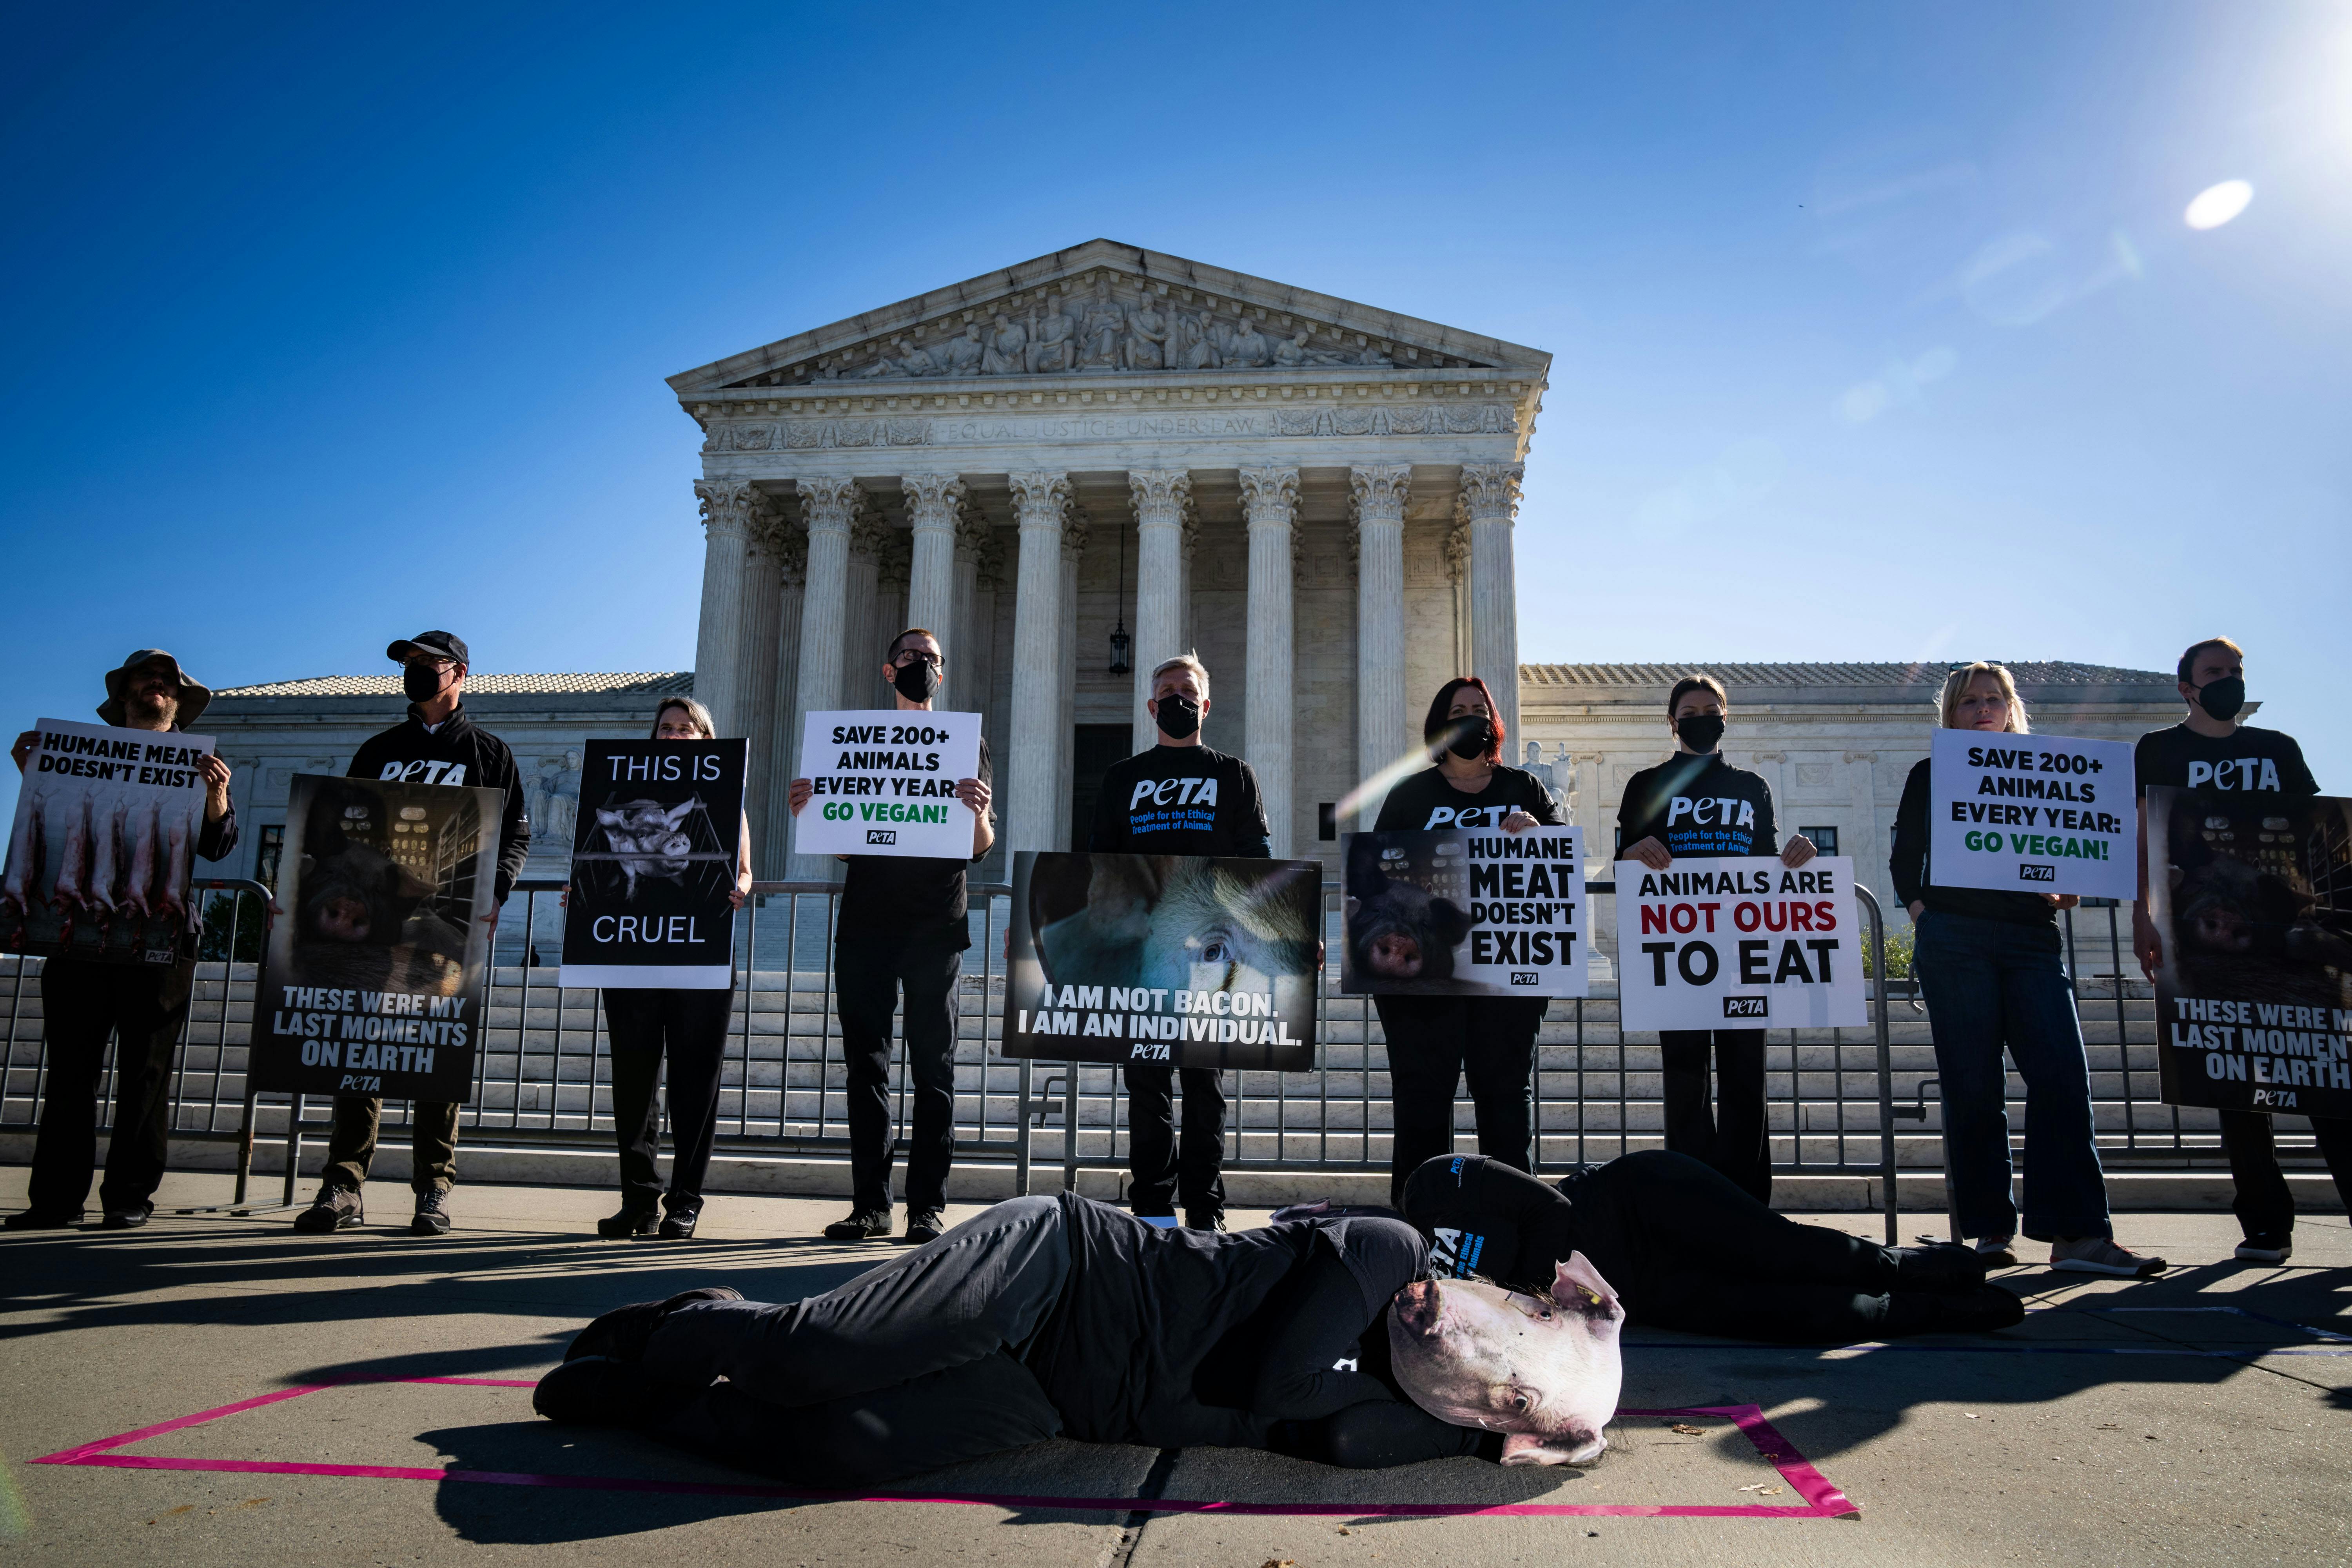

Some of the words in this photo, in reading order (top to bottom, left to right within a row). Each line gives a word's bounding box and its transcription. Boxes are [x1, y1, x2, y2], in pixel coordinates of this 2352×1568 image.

[948, 422, 1022, 440] EQUAL
[1028, 420, 1114, 437] JUSTICE
[1127, 418, 1202, 434] UNDER
[1211, 417, 1255, 433] LAW
[43, 732, 141, 760] HUMANE
[145, 745, 202, 767] MEAT
[832, 726, 886, 744] SAVE
[891, 726, 949, 745] 200+
[38, 754, 135, 782] DOESN'T
[139, 766, 199, 788] EXIST
[607, 756, 680, 780] THIS
[693, 755, 720, 780] IS
[837, 752, 940, 771] ANIMALS
[1968, 748, 2033, 770] SAVE
[2039, 753, 2102, 775] 200+
[814, 777, 886, 795] EVERY
[1978, 776, 2095, 803] ANIMALS
[823, 802, 853, 820] GO
[860, 803, 947, 823] VEGAN!
[1130, 811, 1154, 825] People
[1157, 811, 1169, 820] for
[1172, 810, 1185, 819] the
[1188, 809, 1215, 821] Ethical
[1952, 802, 2038, 826] EVERY
[2043, 808, 2120, 834] YEAR:
[1132, 822, 1170, 835] Treatment
[1172, 820, 1181, 829] of
[1183, 820, 1212, 831] Animals
[1668, 830, 1697, 842] People
[1699, 830, 1713, 839] for
[1715, 830, 1730, 840] the
[1733, 831, 1753, 845] Ethical
[1468, 837, 1573, 859] HUMANE
[1671, 842, 1715, 853] Treatment
[1717, 842, 1726, 850] of
[1728, 842, 1749, 855] Animals
[1965, 831, 2003, 852] GO
[2010, 834, 2108, 860] VEGAN!
[1470, 864, 1574, 899] MEAT
[1638, 871, 1770, 897] ANIMALS
[1779, 871, 1833, 893] ARE
[1471, 902, 1575, 925] DOESN'T
[1641, 903, 1720, 934] NOT
[1733, 901, 1837, 932] OURS
[593, 916, 705, 942] CRUEL
[1472, 931, 1577, 965] EXIST
[1642, 940, 1719, 986] TO
[1739, 939, 1839, 984] EAT
[283, 986, 356, 1011] THESE
[362, 991, 425, 1015] WERE
[429, 996, 467, 1019] MY
[1044, 984, 1053, 1007] I
[1058, 985, 1103, 1009] AM
[1110, 987, 1168, 1012] NOT
[1174, 990, 1278, 1018] BACON.
[2174, 998, 2252, 1024] THESE
[2257, 1004, 2327, 1030] WERE
[2332, 1009, 2352, 1032] M
[274, 1011, 336, 1037] LAST
[341, 1016, 467, 1046] MOMENTS
[1018, 1010, 1027, 1033] I
[1032, 1011, 1077, 1035] AM
[1083, 1013, 1123, 1037] AN
[1129, 1015, 1302, 1046] INDIVIDUAL.
[2171, 1023, 2235, 1050] LAST
[2242, 1028, 2352, 1059] MOMEN
[301, 1040, 340, 1067] ON
[346, 1043, 434, 1073] EARTH
[2206, 1053, 2246, 1081] ON
[2253, 1056, 2351, 1090] EARTH
[1460, 1232, 1474, 1260] Ethical
[1468, 1235, 1485, 1269] Animals
